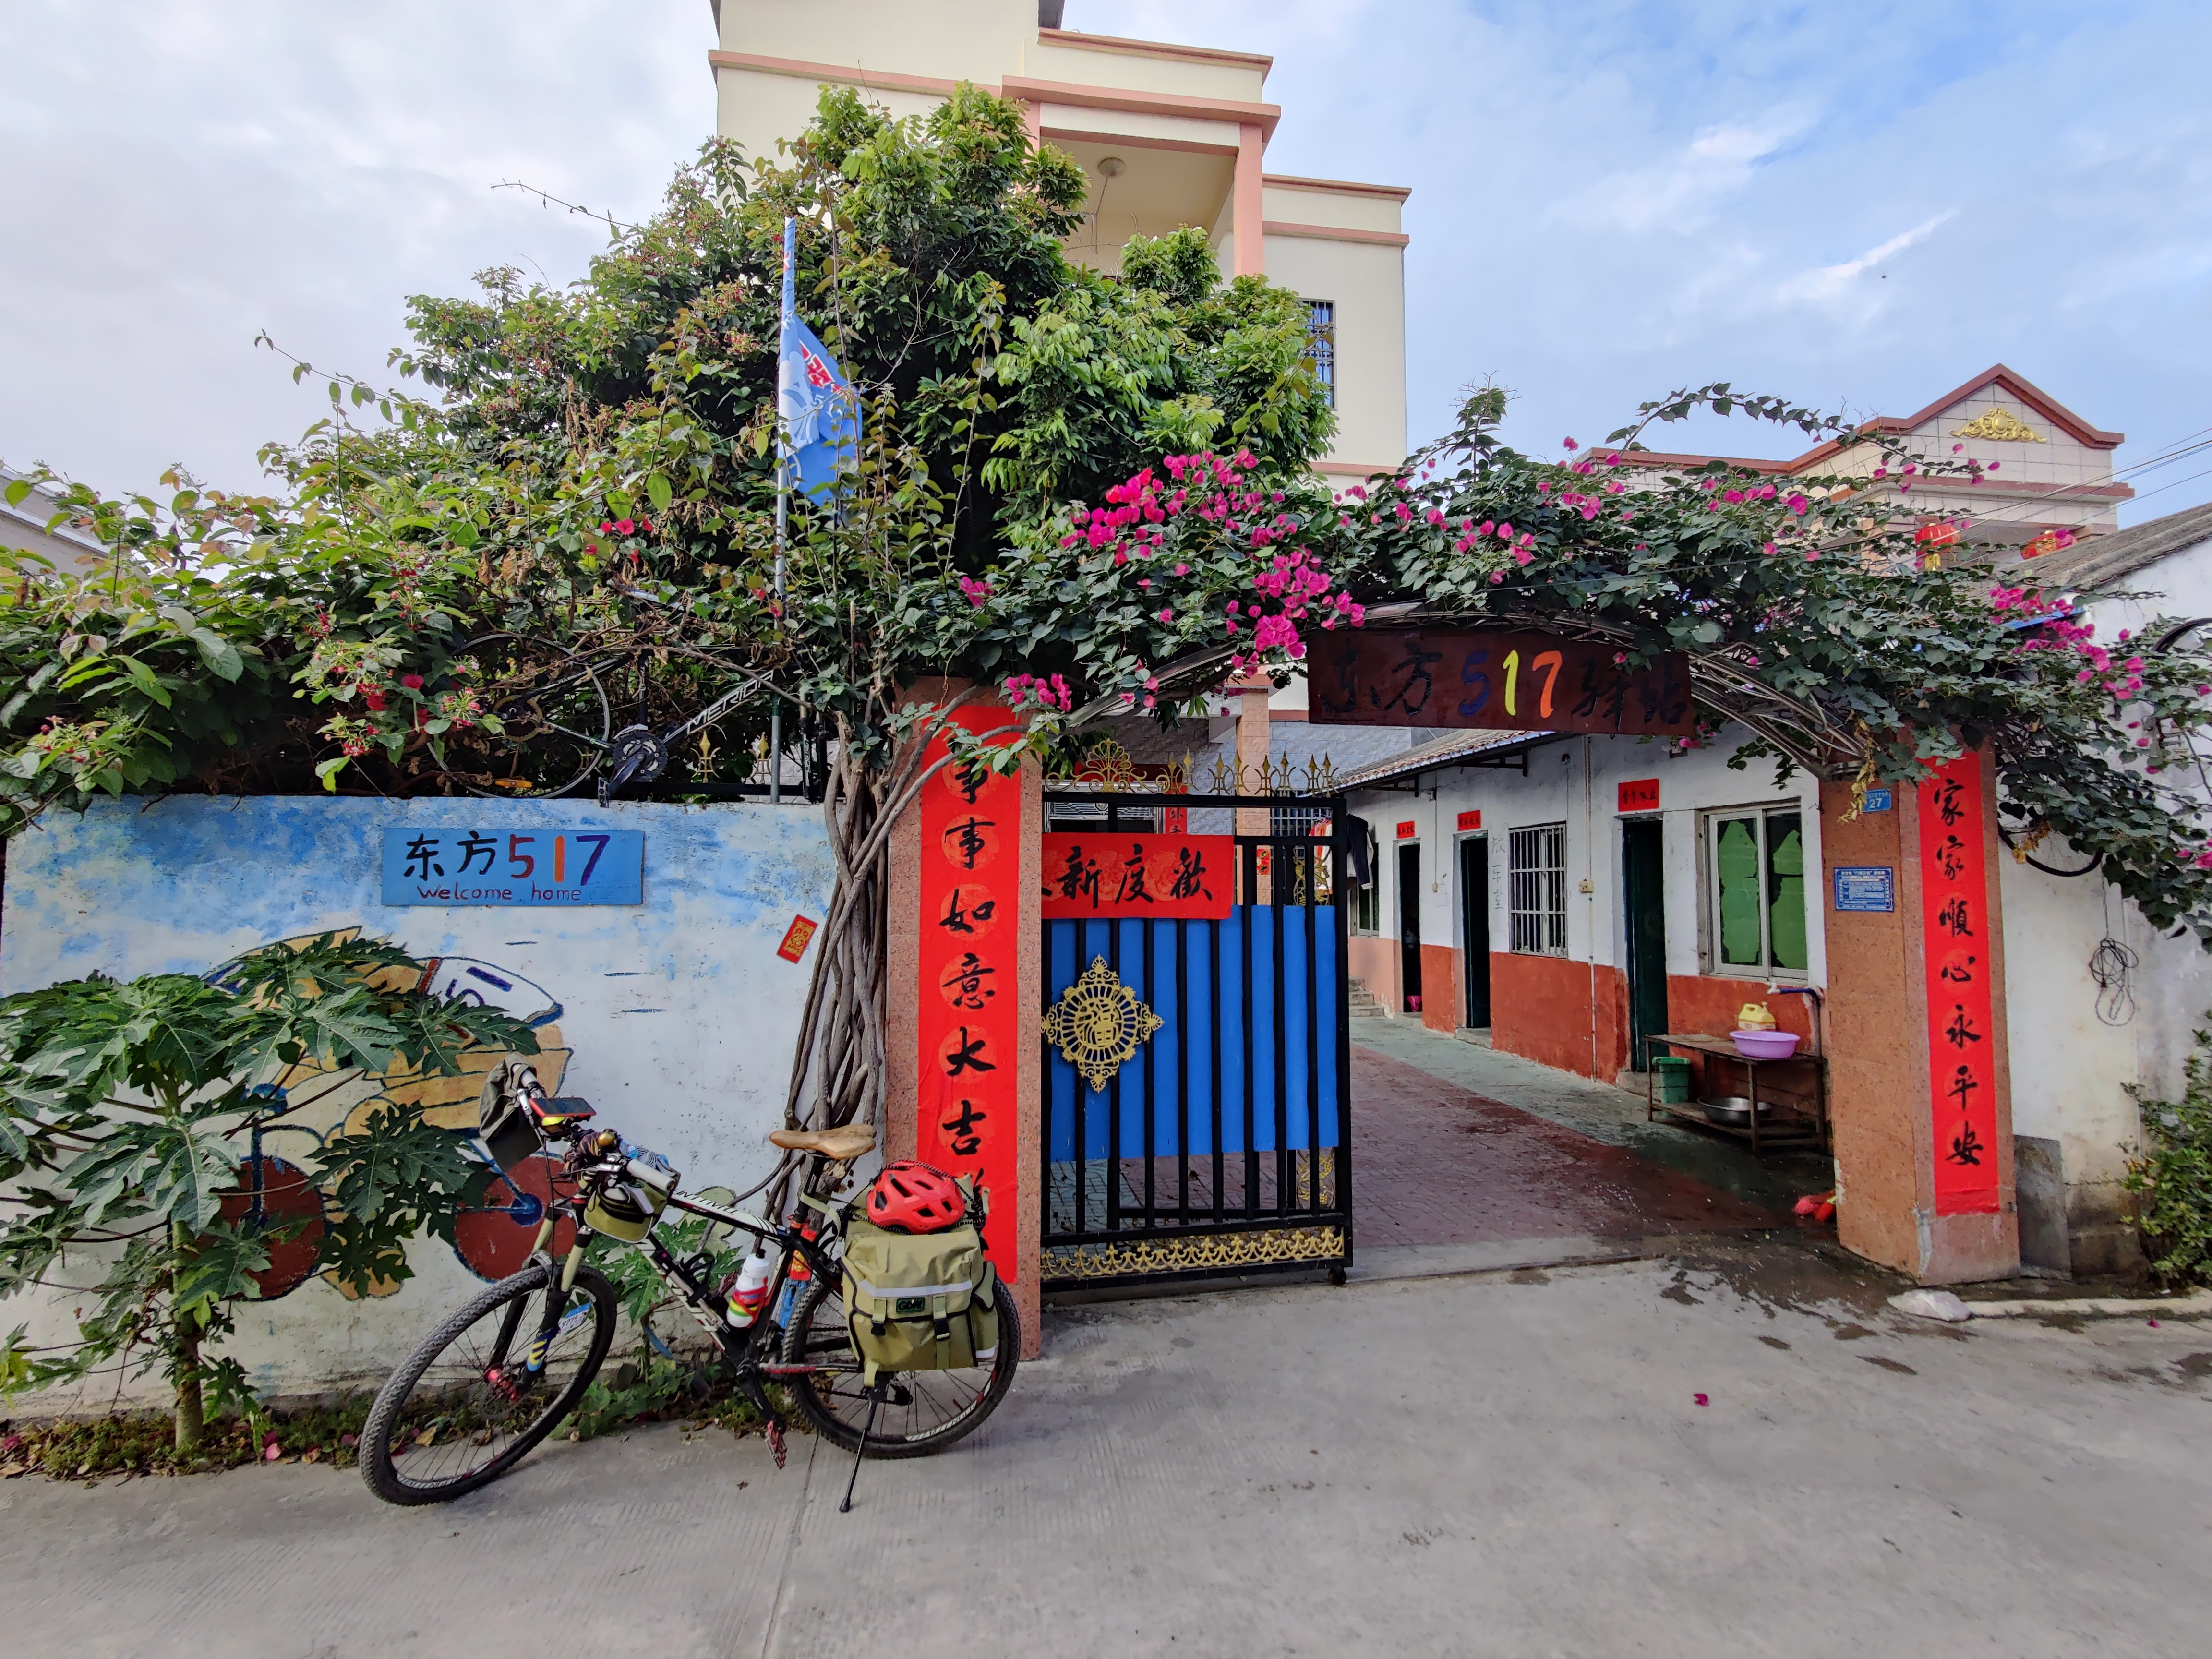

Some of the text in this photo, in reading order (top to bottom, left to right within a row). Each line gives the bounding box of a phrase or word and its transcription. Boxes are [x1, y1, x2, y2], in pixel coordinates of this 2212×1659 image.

[686, 669, 774, 735] MERIDA
[1869, 798, 1883, 808] 27
[403, 830, 611, 887] 东方517
[530, 880, 582, 901] home
[939, 757, 997, 1200] 事事如意大吉
